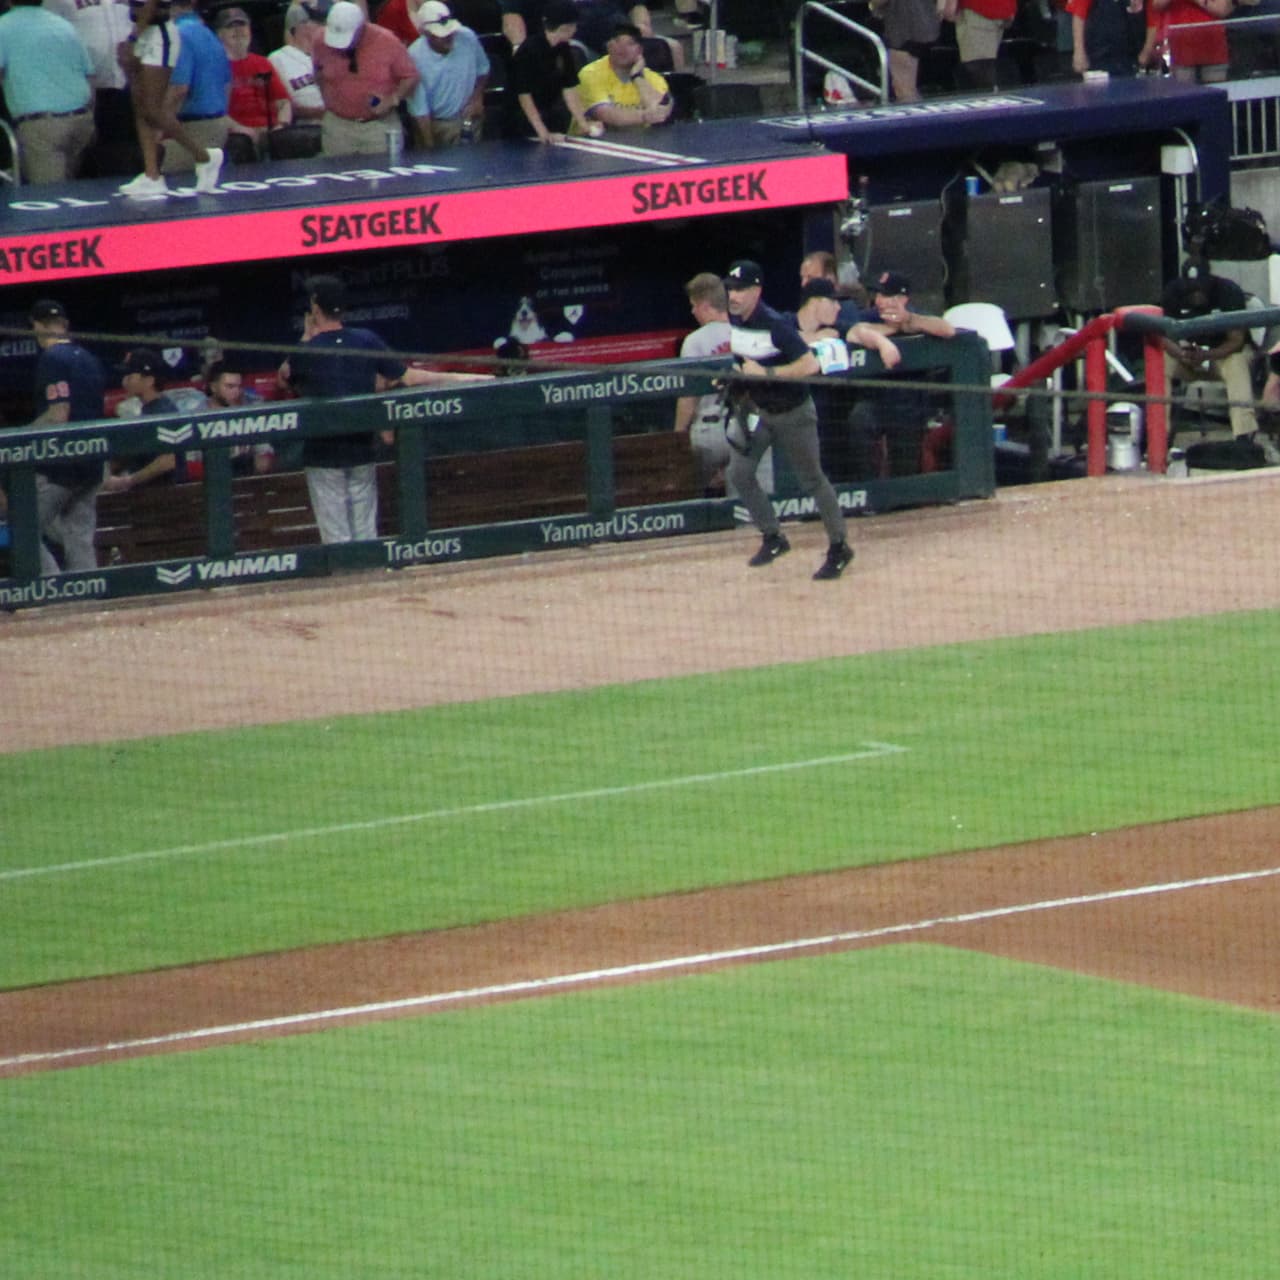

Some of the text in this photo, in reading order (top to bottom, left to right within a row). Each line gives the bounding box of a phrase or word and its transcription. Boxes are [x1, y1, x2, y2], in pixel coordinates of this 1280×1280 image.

[632, 169, 767, 214] SEATGEEK
[301, 203, 442, 247] SEATGEEK
[540, 373, 685, 404] YanmarUS.com
[384, 397, 463, 421] Tractors
[197, 412, 299, 439] YANMAR
[771, 490, 867, 518] YANAR
[540, 513, 685, 543] YanmarUS.com
[384, 537, 462, 561] Tractors
[197, 553, 297, 580] YANMAR
